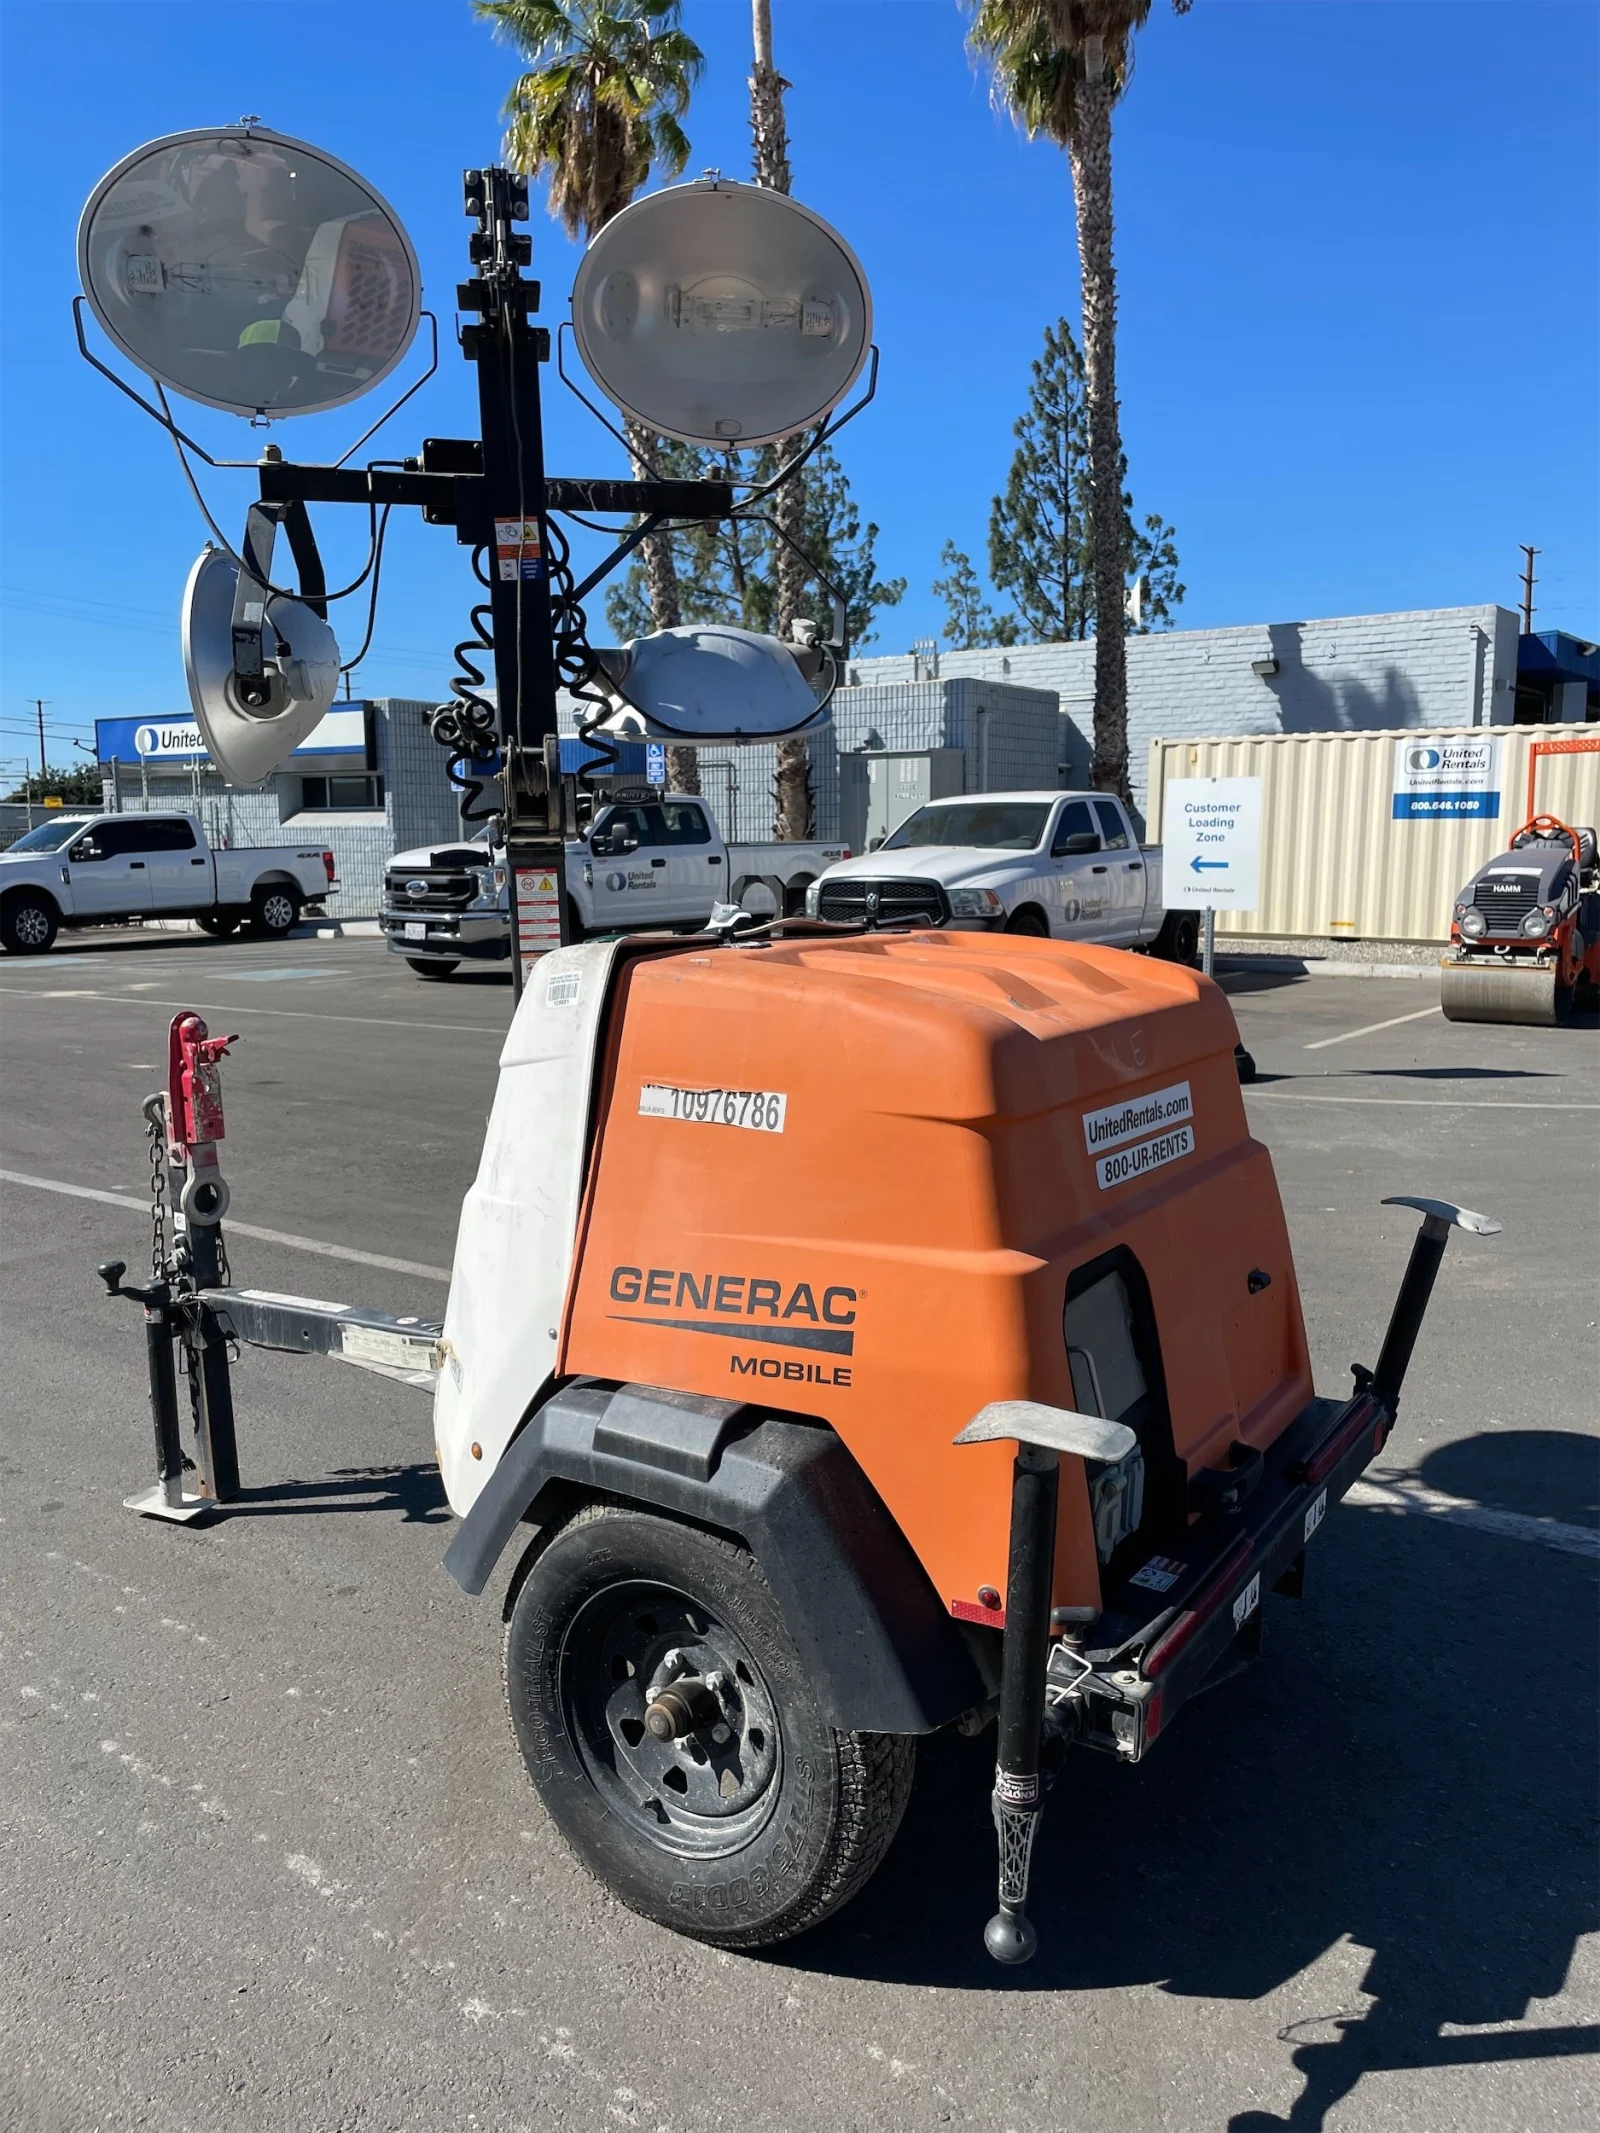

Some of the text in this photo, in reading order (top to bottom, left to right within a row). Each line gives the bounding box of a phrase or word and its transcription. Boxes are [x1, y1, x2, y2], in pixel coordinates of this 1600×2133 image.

[1443, 748, 1483, 758] United
[1442, 760, 1486, 769] Rentals
[1184, 803, 1241, 813] Customer
[1188, 818, 1235, 829] Loading
[1196, 832, 1226, 842] Zone
[627, 871, 655, 880] United
[628, 881, 656, 890] Rentals
[1493, 885, 1521, 893] HAMM
[670, 1090, 780, 1130] 10976786
[1088, 1096, 1189, 1144] UnitedRentals.com
[1105, 1130, 1188, 1182] 800-UR-RENTS
[610, 1266, 857, 1325] GENERAC
[730, 1355, 852, 1387] MOBILE
